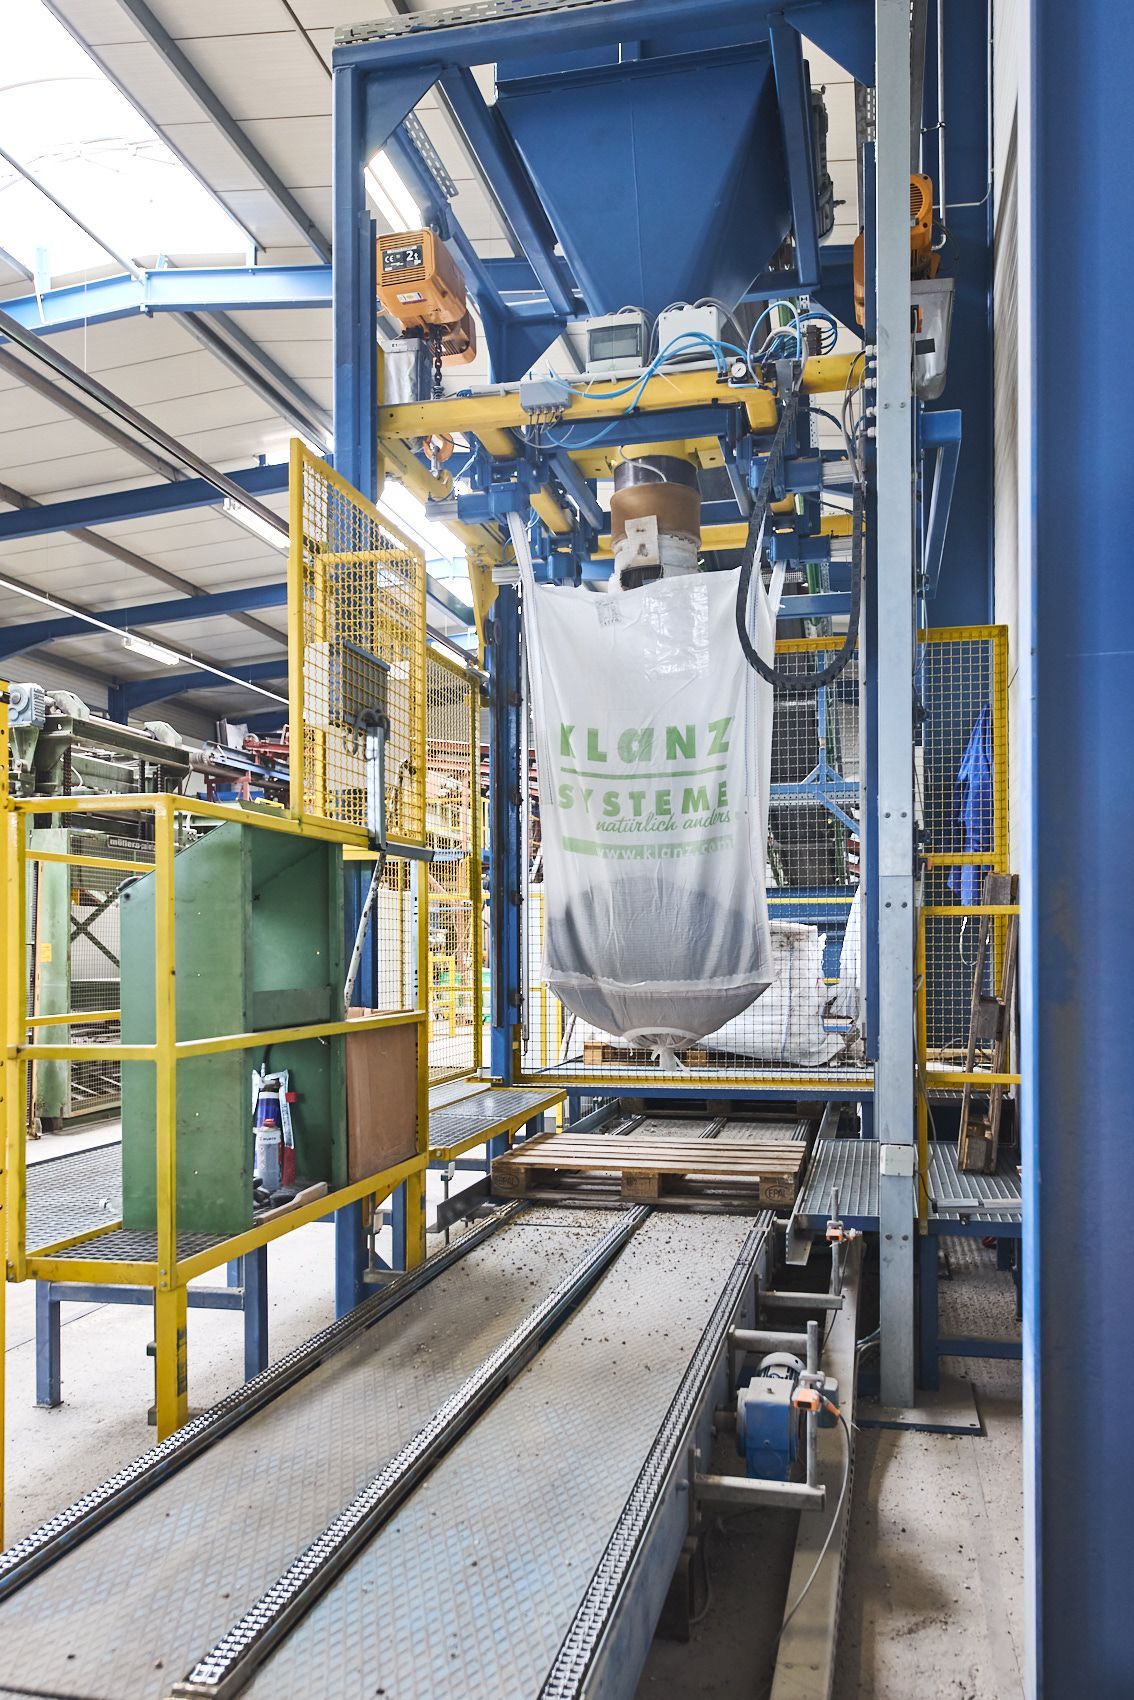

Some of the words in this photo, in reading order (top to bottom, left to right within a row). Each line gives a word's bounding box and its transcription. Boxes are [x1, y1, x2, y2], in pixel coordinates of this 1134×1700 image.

[558, 780, 729, 817] SYSTEME
[595, 811, 678, 833] natürlich
[682, 808, 731, 830] anders
[594, 839, 736, 860] www.klanz.com
